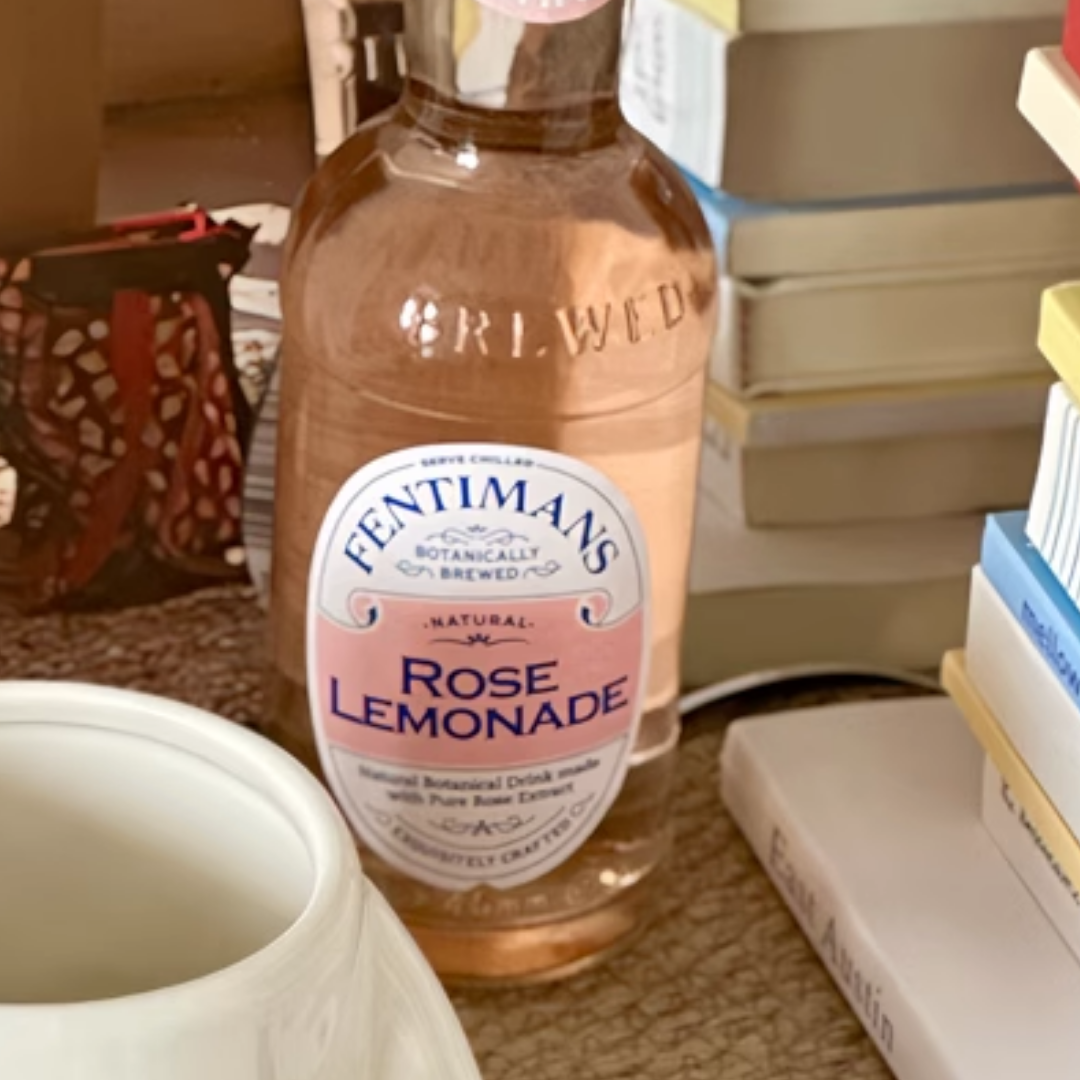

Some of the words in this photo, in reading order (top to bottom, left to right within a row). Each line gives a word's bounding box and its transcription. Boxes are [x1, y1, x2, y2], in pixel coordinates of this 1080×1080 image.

[344, 475, 620, 576] FENTIMANS
[415, 545, 541, 564] BOTANICALLY
[440, 566, 519, 582] BREWED
[401, 655, 560, 700] ROSE
[330, 675, 629, 741] LEMONADE
[358, 764, 418, 787] Natural
[423, 775, 502, 791] Botanical
[507, 771, 552, 790] Drink
[557, 757, 600, 778] made
[387, 789, 424, 804] with
[429, 793, 467, 807] Pure
[473, 794, 513, 807] Rose
[519, 781, 574, 804] Extract
[391, 825, 496, 867] EXQUISITELY
[500, 818, 572, 864] CRAFTED
[822, 915, 894, 1054] Austin
